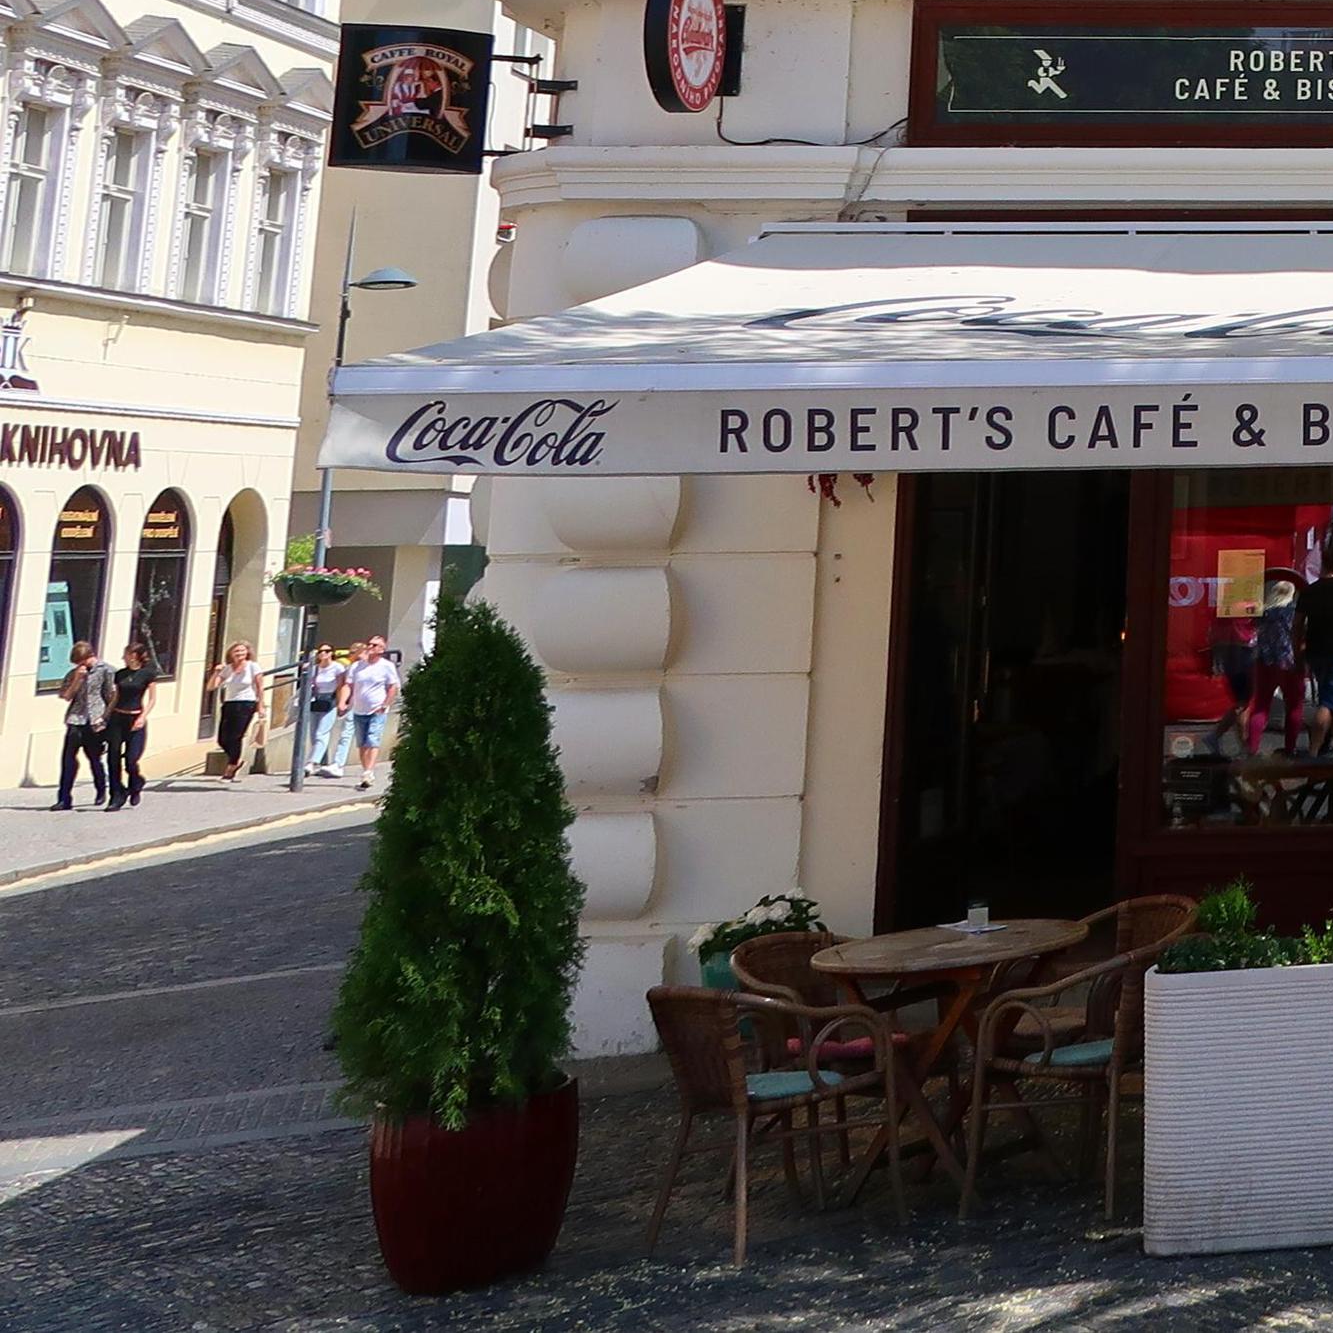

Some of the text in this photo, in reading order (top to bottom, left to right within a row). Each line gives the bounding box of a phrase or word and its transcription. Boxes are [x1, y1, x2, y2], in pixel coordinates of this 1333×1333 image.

[424, 48, 468, 72] ROYAL
[1174, 73, 1249, 101] CAFÉ
[1263, 78, 1281, 101] &
[363, 116, 460, 151] UNIVERSAL
[385, 398, 621, 468] Coca-Cola
[718, 405, 1014, 454] ROBERT'S
[1046, 392, 1200, 451] CAFÉ
[1231, 402, 1267, 449] &
[1, 422, 141, 472] KNIHOVNA
